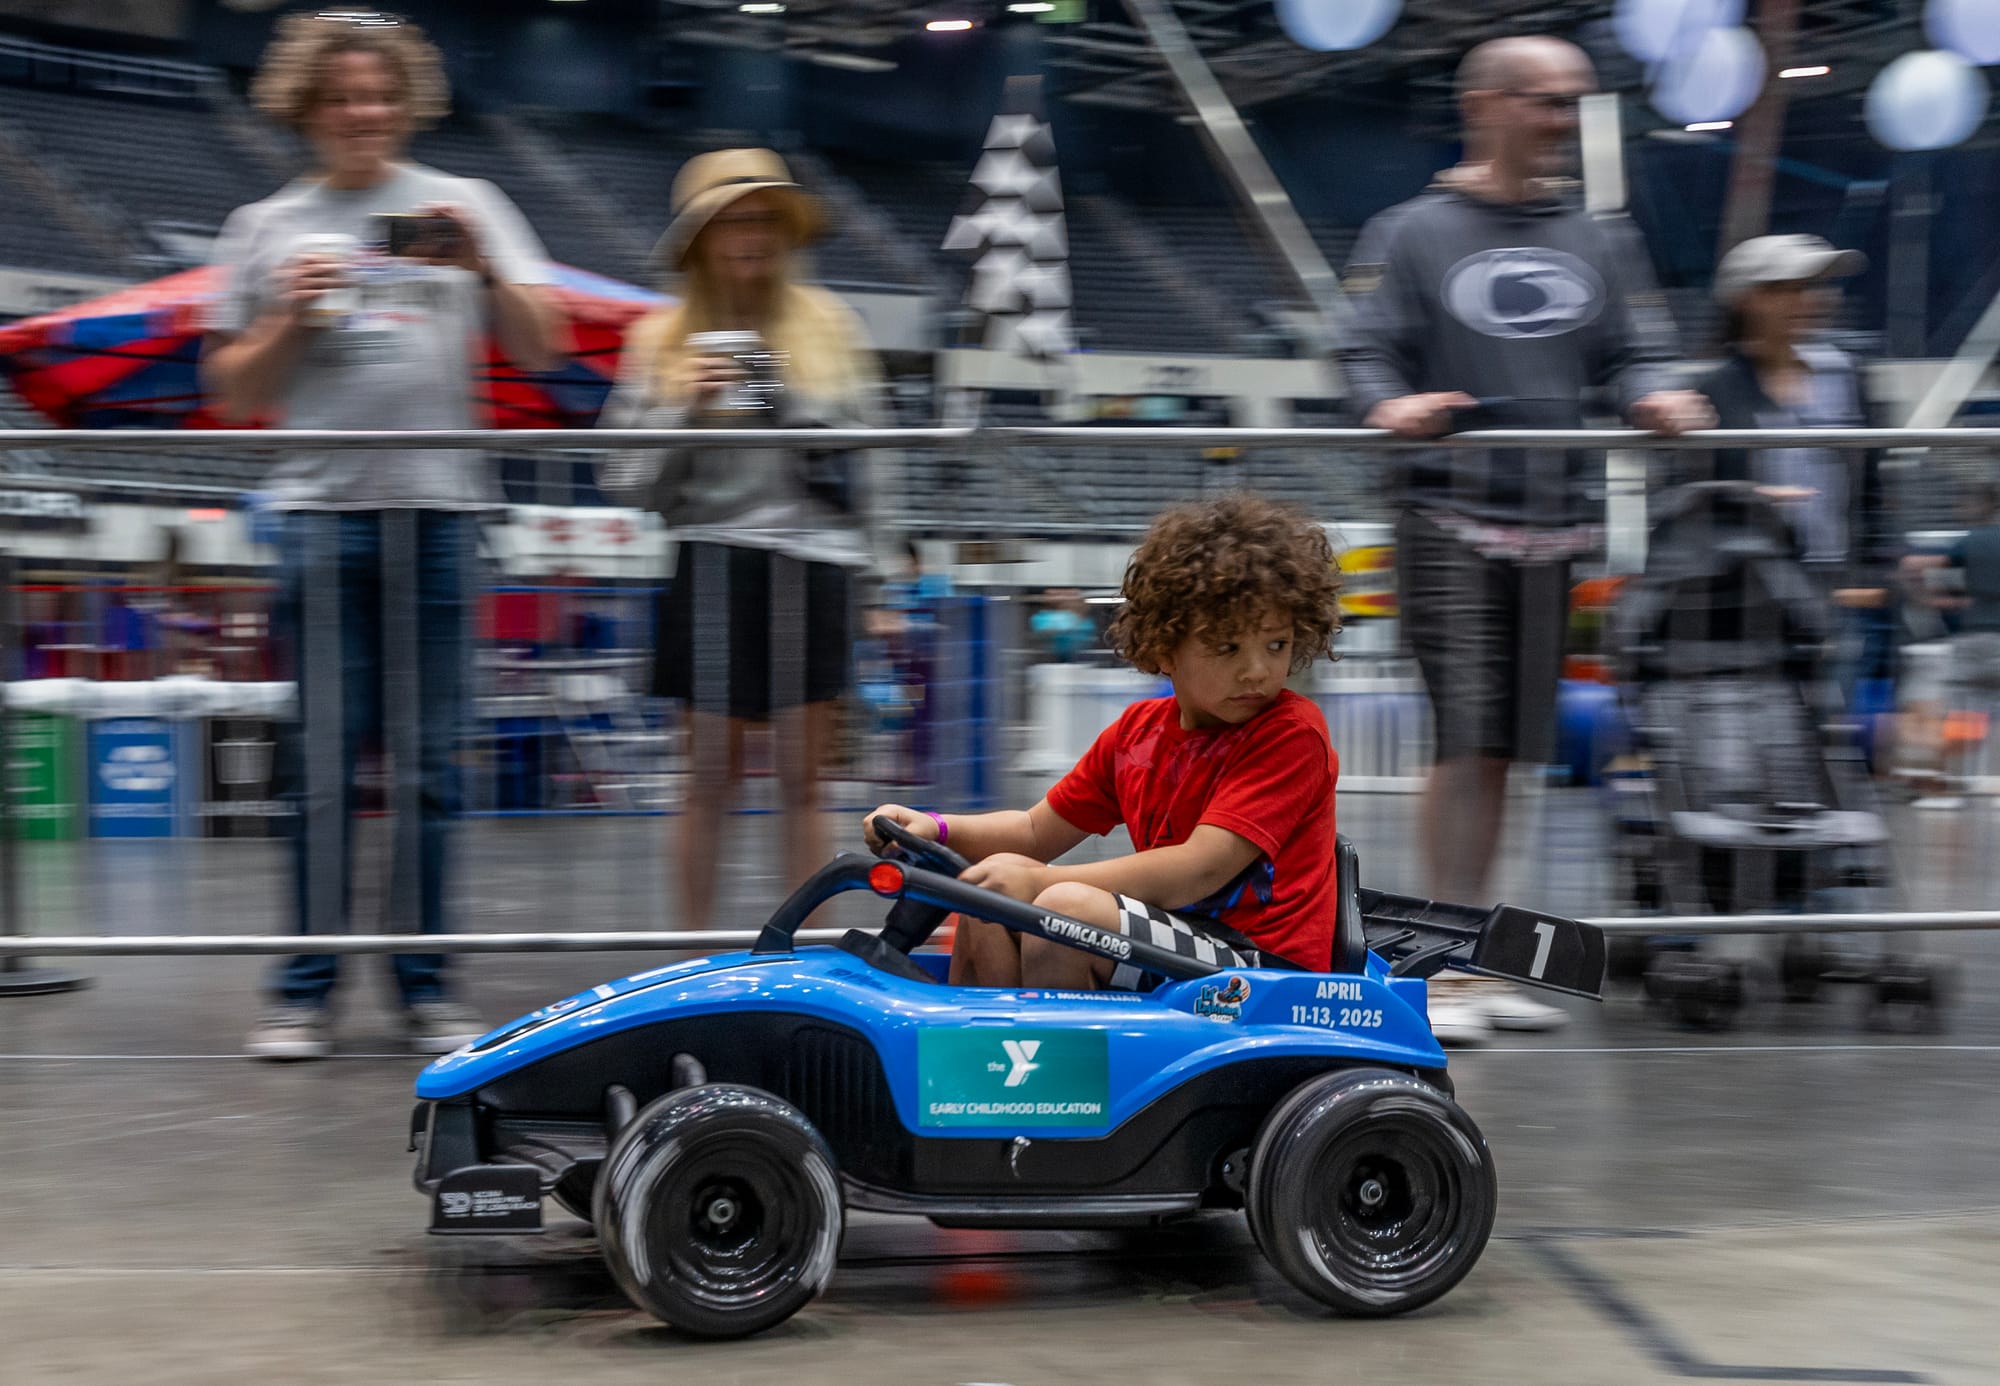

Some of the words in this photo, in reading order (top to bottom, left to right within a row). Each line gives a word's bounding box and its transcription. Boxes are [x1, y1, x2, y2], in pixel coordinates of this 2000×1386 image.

[1530, 921, 1556, 979] 1
[1315, 981, 1363, 1000] APRIL
[1291, 1005, 1335, 1028] 11-13,
[1339, 1008, 1383, 1027] 2025
[987, 1061, 1005, 1072] the
[1001, 1040, 1041, 1087] Y
[929, 1102, 965, 1115] EARLY
[966, 1102, 1035, 1115] CHILDHOOD
[1036, 1102, 1101, 1115] EDUCATION
